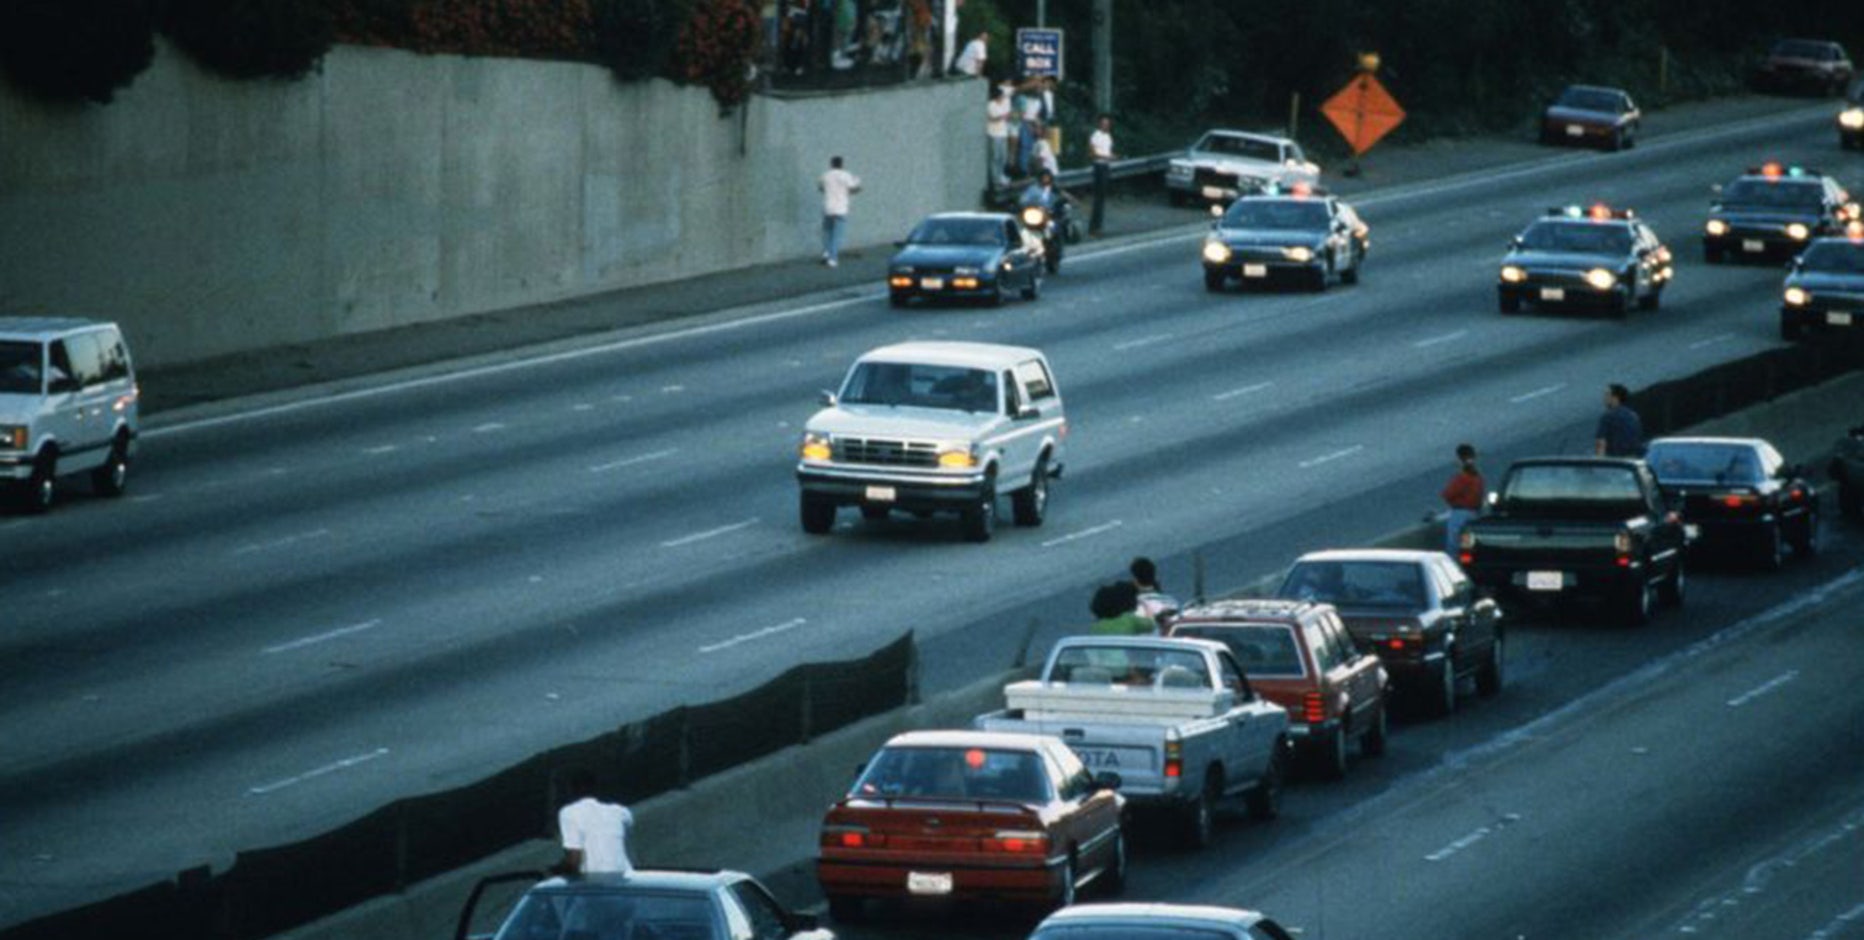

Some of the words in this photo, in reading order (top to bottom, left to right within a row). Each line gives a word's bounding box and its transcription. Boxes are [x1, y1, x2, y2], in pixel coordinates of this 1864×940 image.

[1023, 42, 1056, 55] CALL
[1026, 57, 1052, 69] BOX
[1078, 751, 1120, 768] OTA
